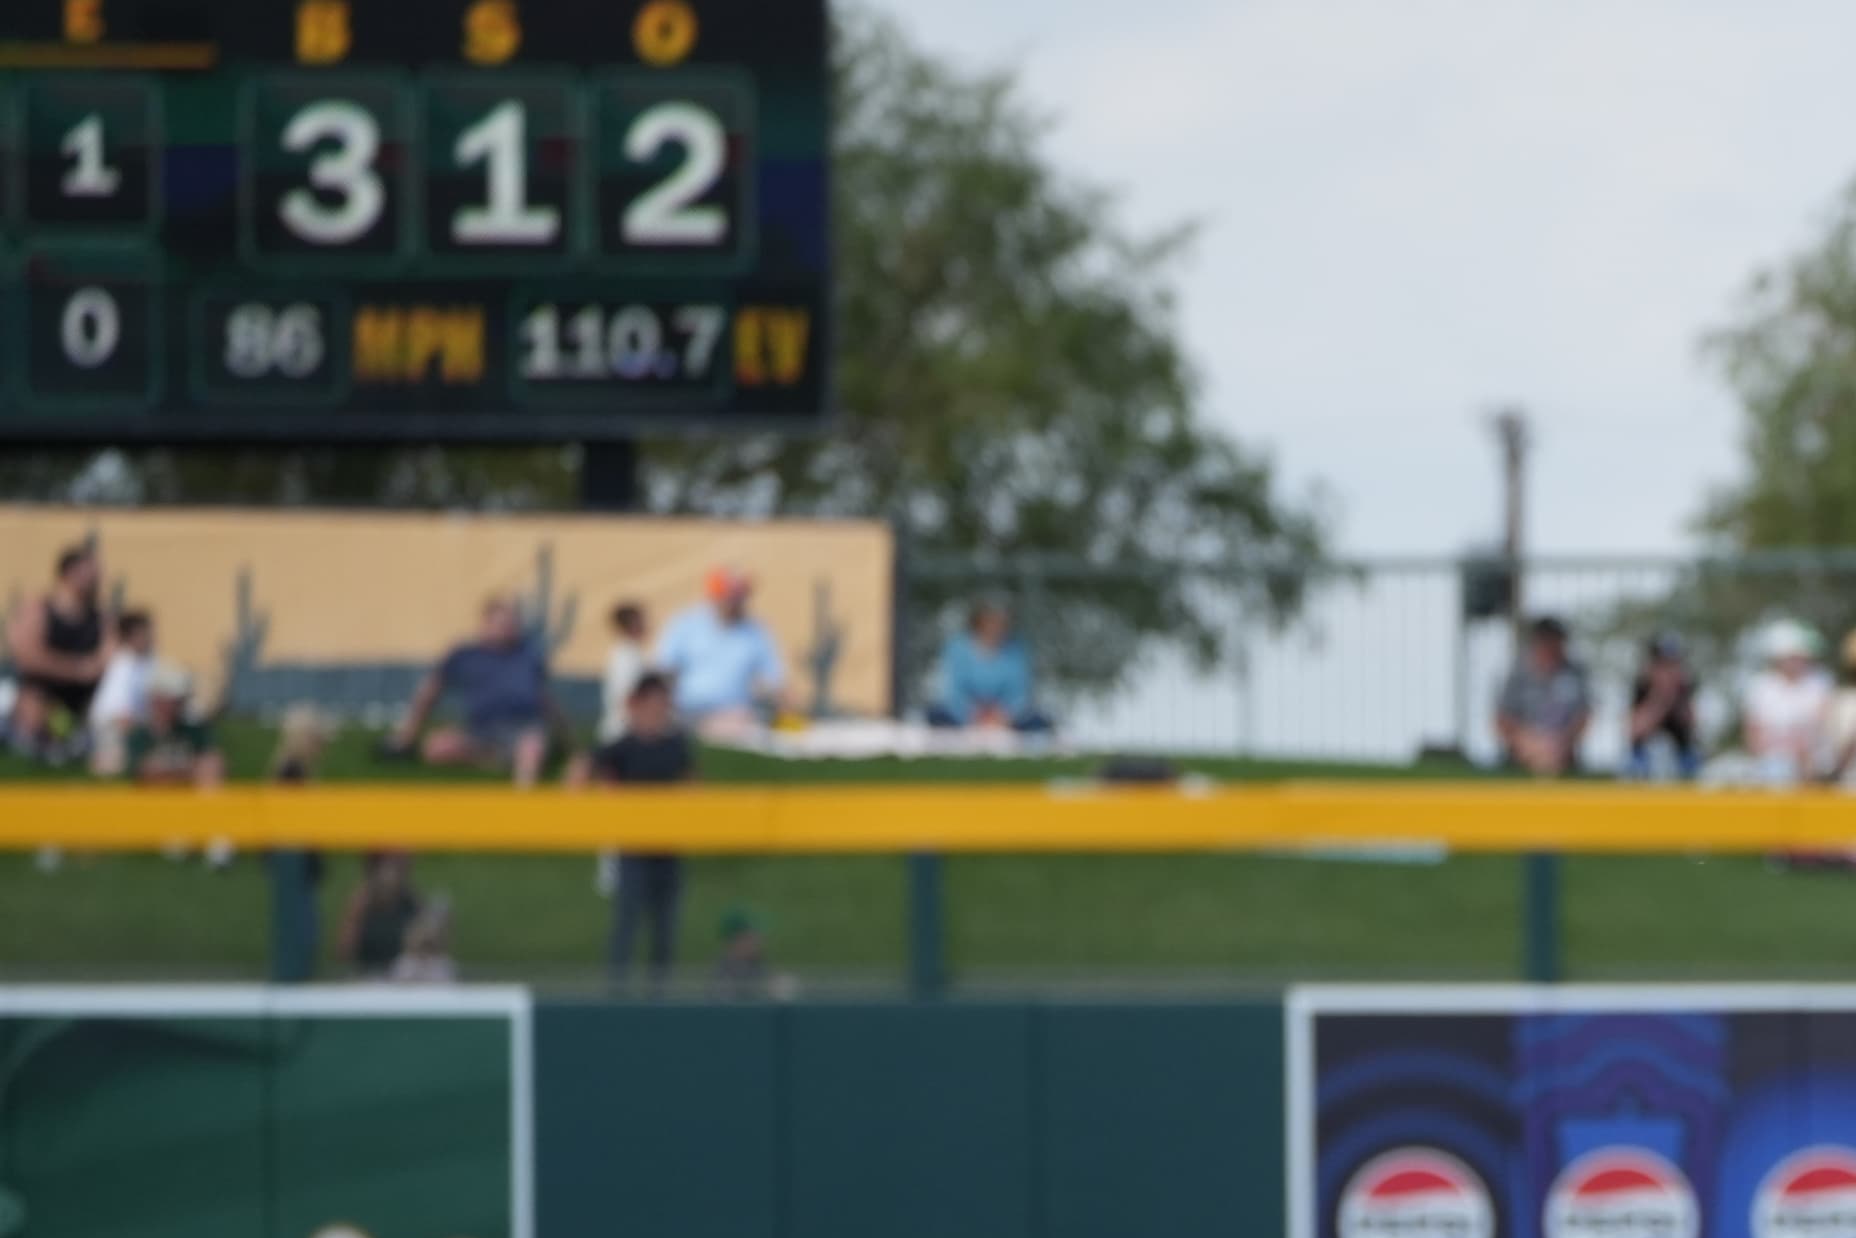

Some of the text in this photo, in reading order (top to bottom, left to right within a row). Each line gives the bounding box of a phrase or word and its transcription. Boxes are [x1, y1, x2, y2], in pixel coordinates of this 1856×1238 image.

[463, 1, 522, 63] S
[632, 0, 698, 65] O
[60, 113, 121, 197] 1
[279, 100, 728, 246] 3 1 2
[60, 287, 119, 368] 0
[225, 303, 324, 378] 86
[519, 303, 726, 380] 110.7
